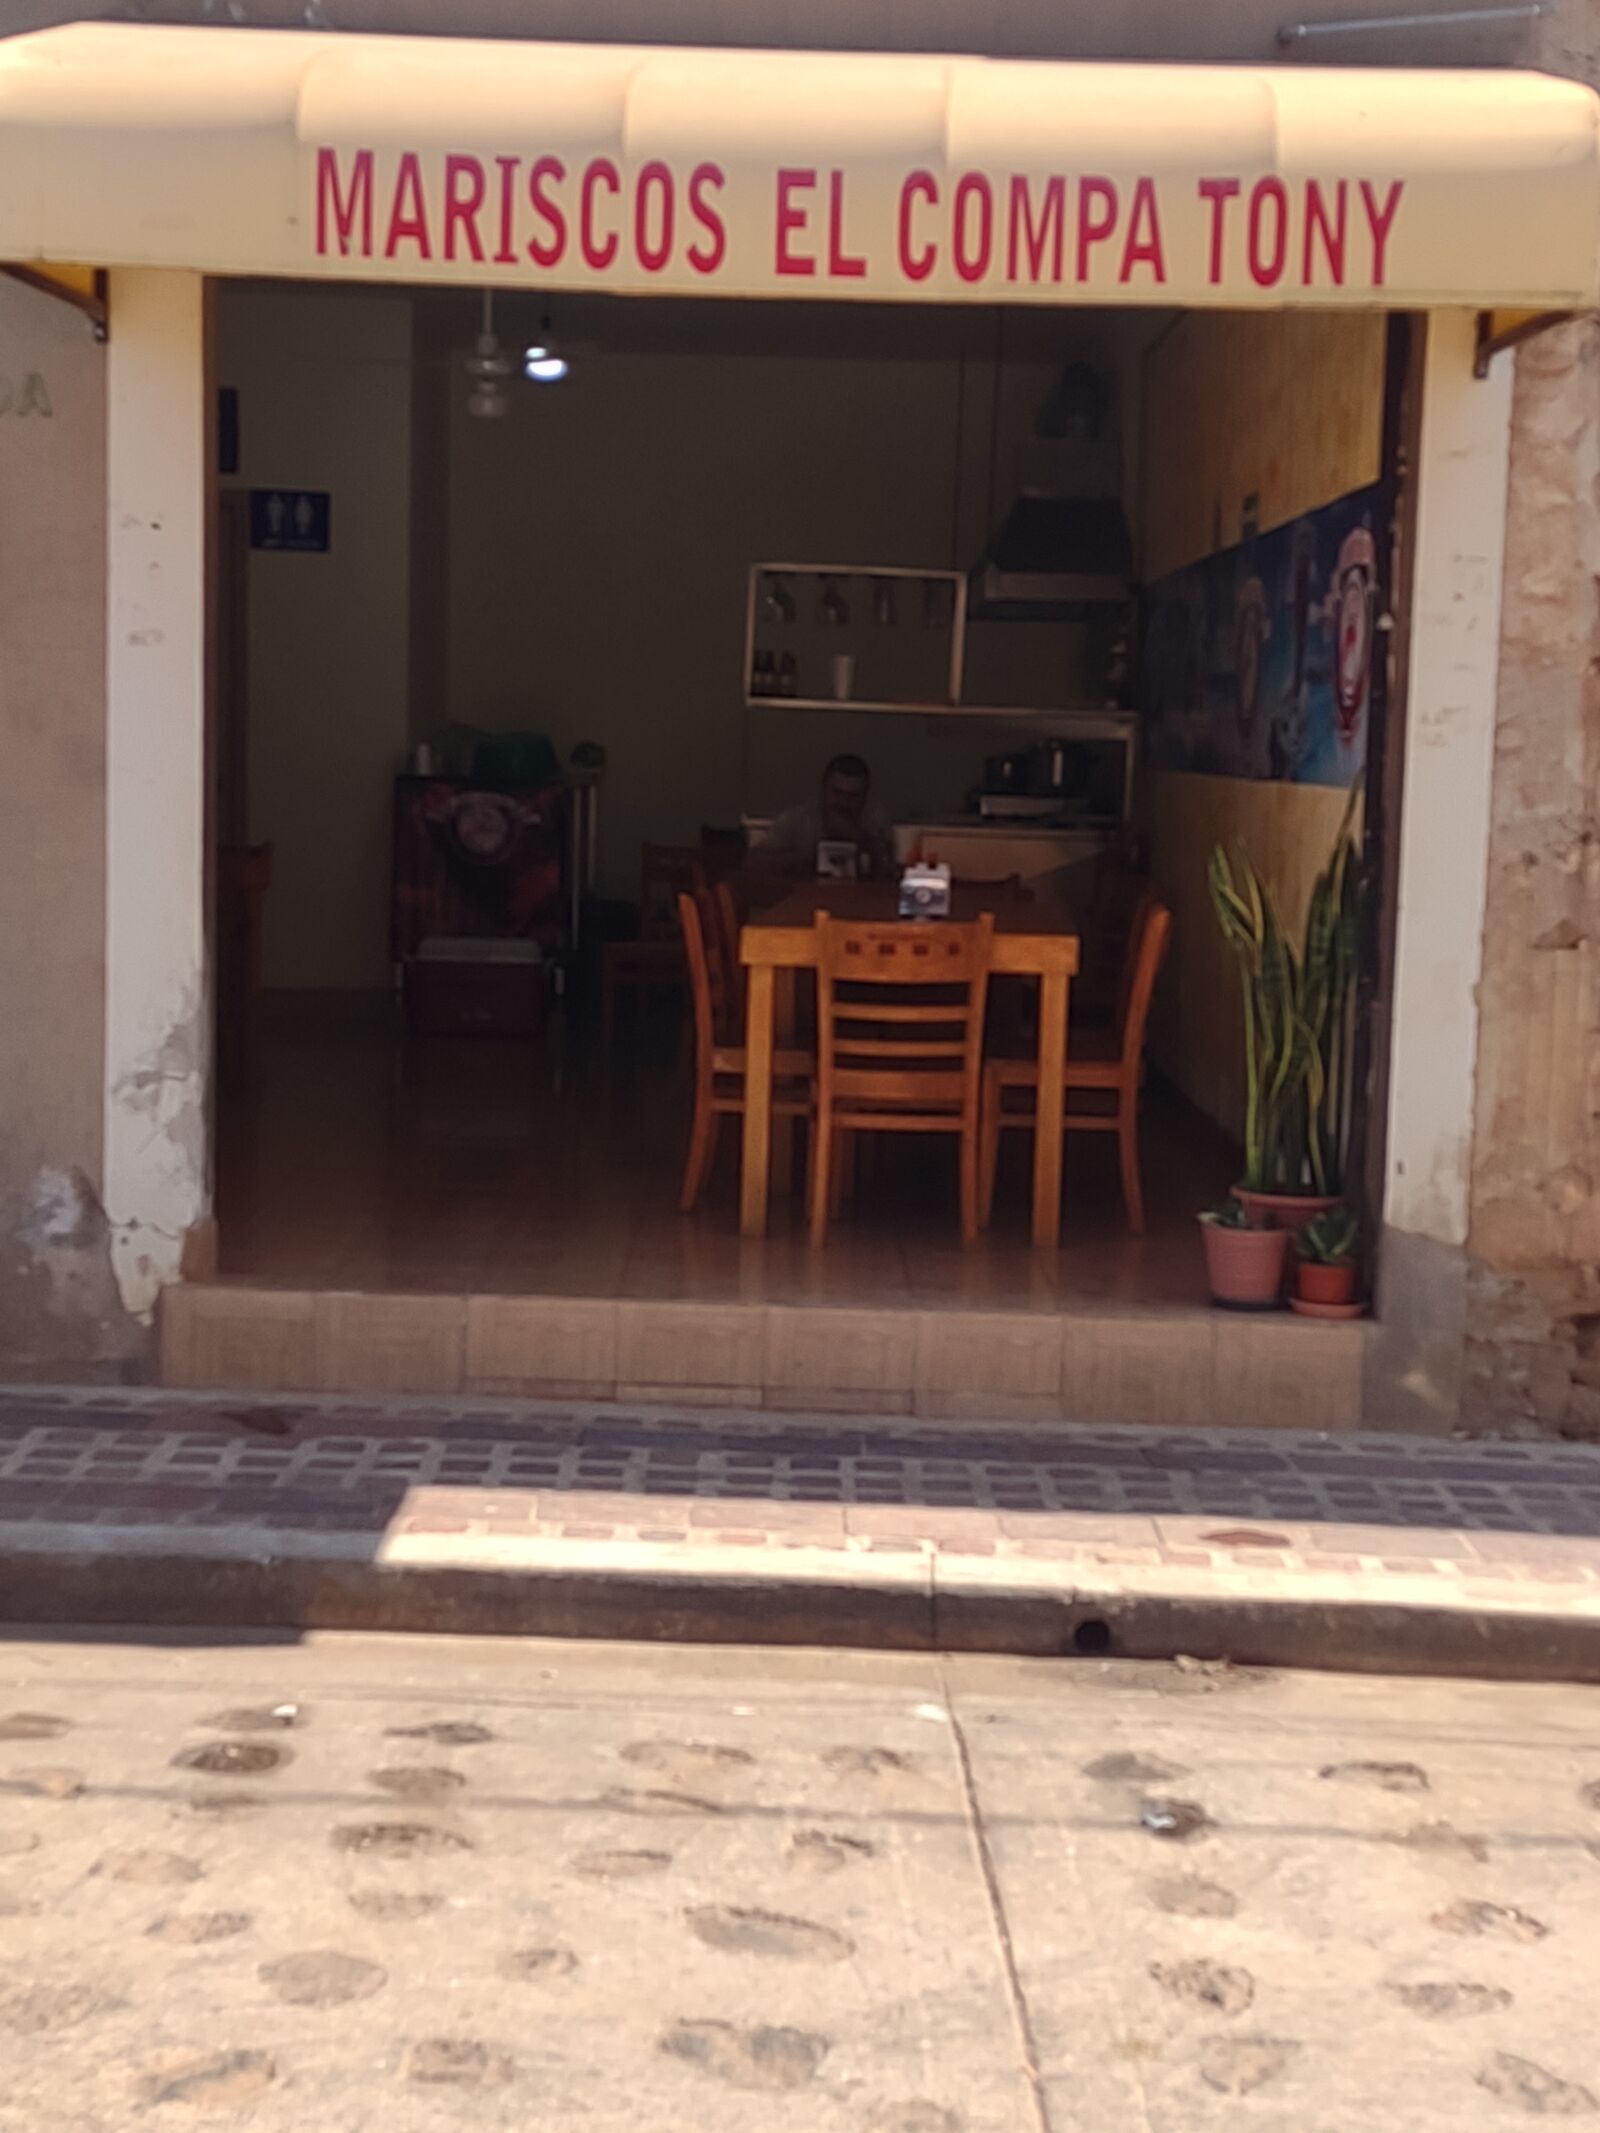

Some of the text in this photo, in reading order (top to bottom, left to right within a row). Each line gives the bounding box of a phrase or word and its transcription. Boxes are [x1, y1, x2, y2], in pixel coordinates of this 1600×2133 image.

[315, 148, 1404, 289] MARISCOS EL COMPA TONY
